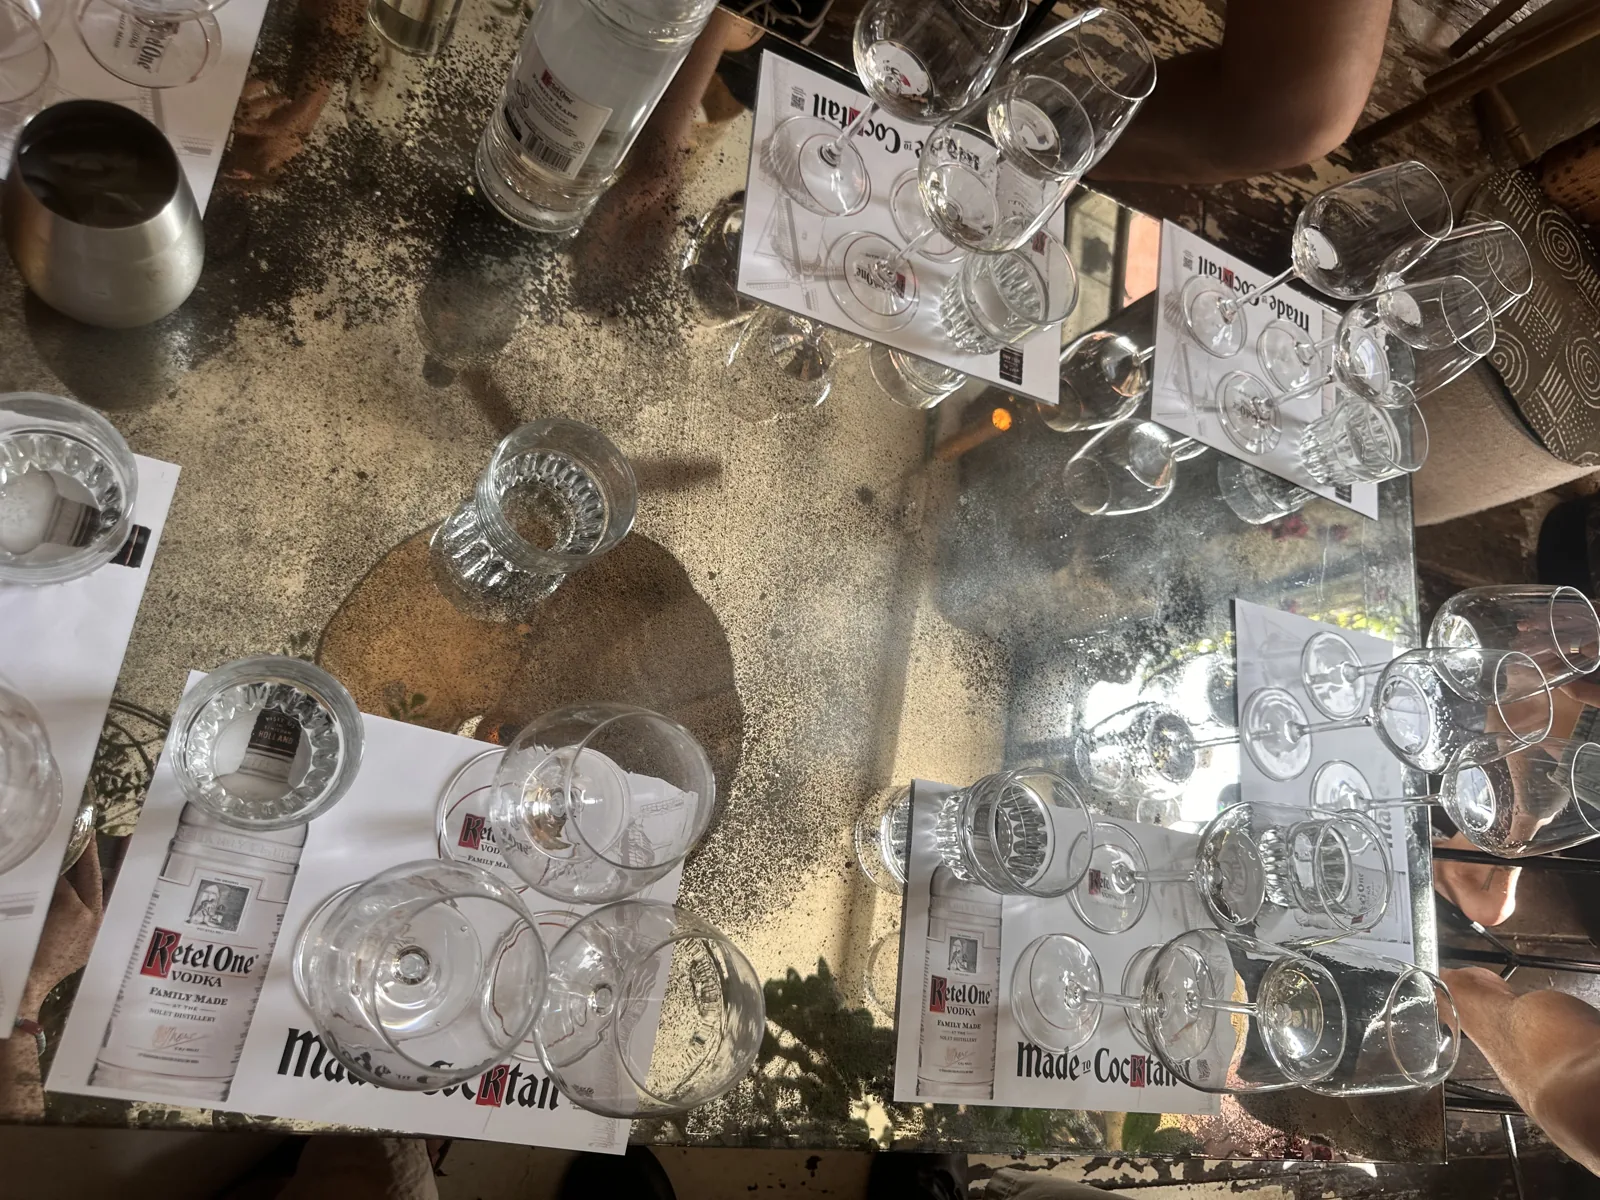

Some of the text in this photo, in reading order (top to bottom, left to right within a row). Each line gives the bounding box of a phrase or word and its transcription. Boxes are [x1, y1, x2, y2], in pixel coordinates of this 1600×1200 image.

[258, 730, 294, 745] HOLLAND
[141, 927, 214, 979] Ketel
[171, 970, 223, 988] VODKA
[149, 986, 229, 1007] FAMILY MADE
[930, 975, 967, 1013] Ketel
[149, 1007, 216, 1023] NOLET DISTILLERY
[946, 1005, 977, 1017] VODKA
[937, 1019, 982, 1030] FAMILY MADE
[1016, 1041, 1080, 1082] Made
